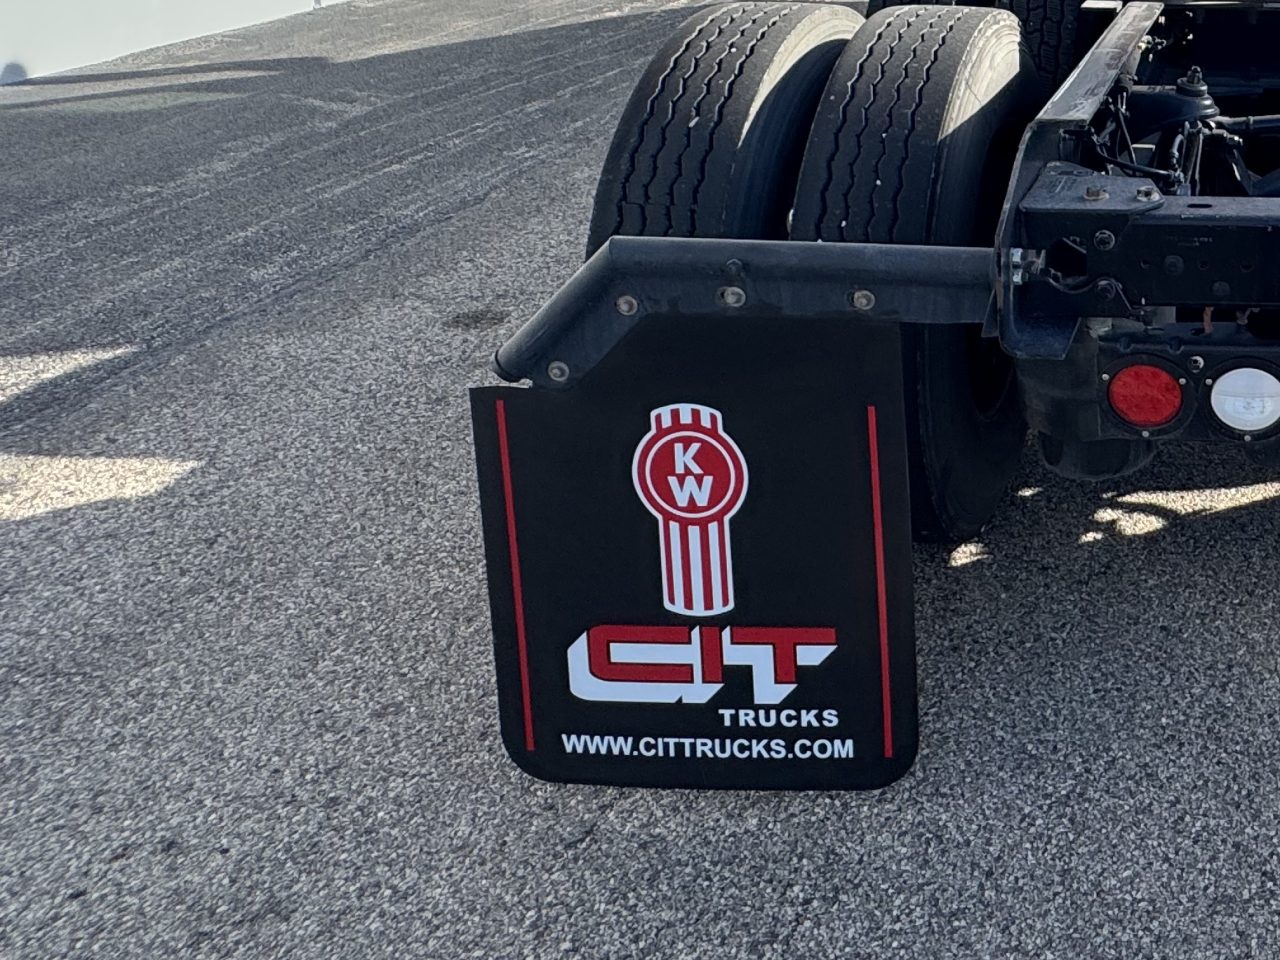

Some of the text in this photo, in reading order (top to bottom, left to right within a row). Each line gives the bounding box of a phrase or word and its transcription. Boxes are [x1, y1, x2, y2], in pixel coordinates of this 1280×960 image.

[567, 625, 838, 705] CIT
[718, 708, 839, 728] TRUCKS
[561, 733, 854, 759] WWW.CITTRUCKS.COM
